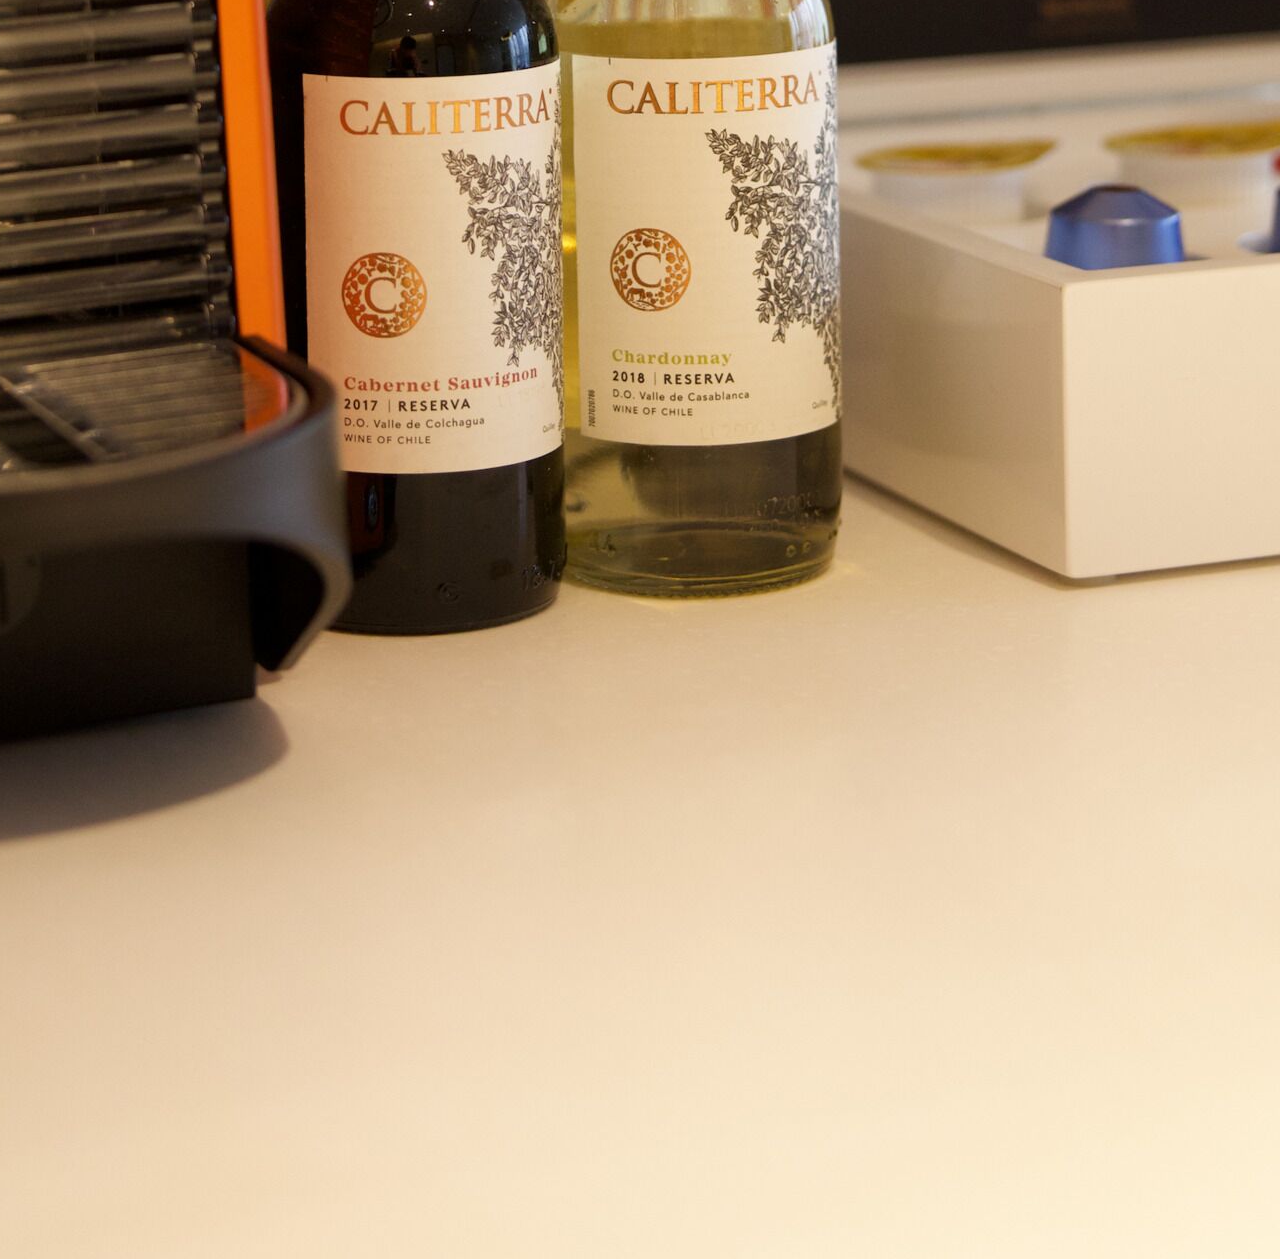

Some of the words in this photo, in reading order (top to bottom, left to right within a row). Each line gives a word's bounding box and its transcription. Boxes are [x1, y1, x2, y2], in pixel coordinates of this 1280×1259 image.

[607, 71, 819, 115] CALITERRA
[339, 89, 550, 136] CALITERRA
[611, 348, 732, 367] Chardonnay
[344, 376, 440, 393] Cabernet
[448, 367, 538, 391] Sauvignon
[612, 370, 646, 384] 2018
[663, 372, 735, 386] RESERVA
[612, 388, 635, 400] D.O.
[639, 391, 666, 402] Valle
[669, 391, 684, 402] de
[687, 390, 750, 402] Casablanca
[344, 398, 378, 412] 2017
[398, 398, 471, 412] RESERVA
[612, 404, 639, 415] WINE
[642, 406, 657, 416] OF
[661, 407, 694, 417] CHILE
[344, 417, 369, 429] D.O.
[373, 419, 402, 430] Valle
[406, 419, 421, 430] de
[425, 416, 485, 430] Colchagua
[344, 433, 373, 444] WINE
[377, 435, 392, 445] OF
[397, 435, 432, 445] CHILE
